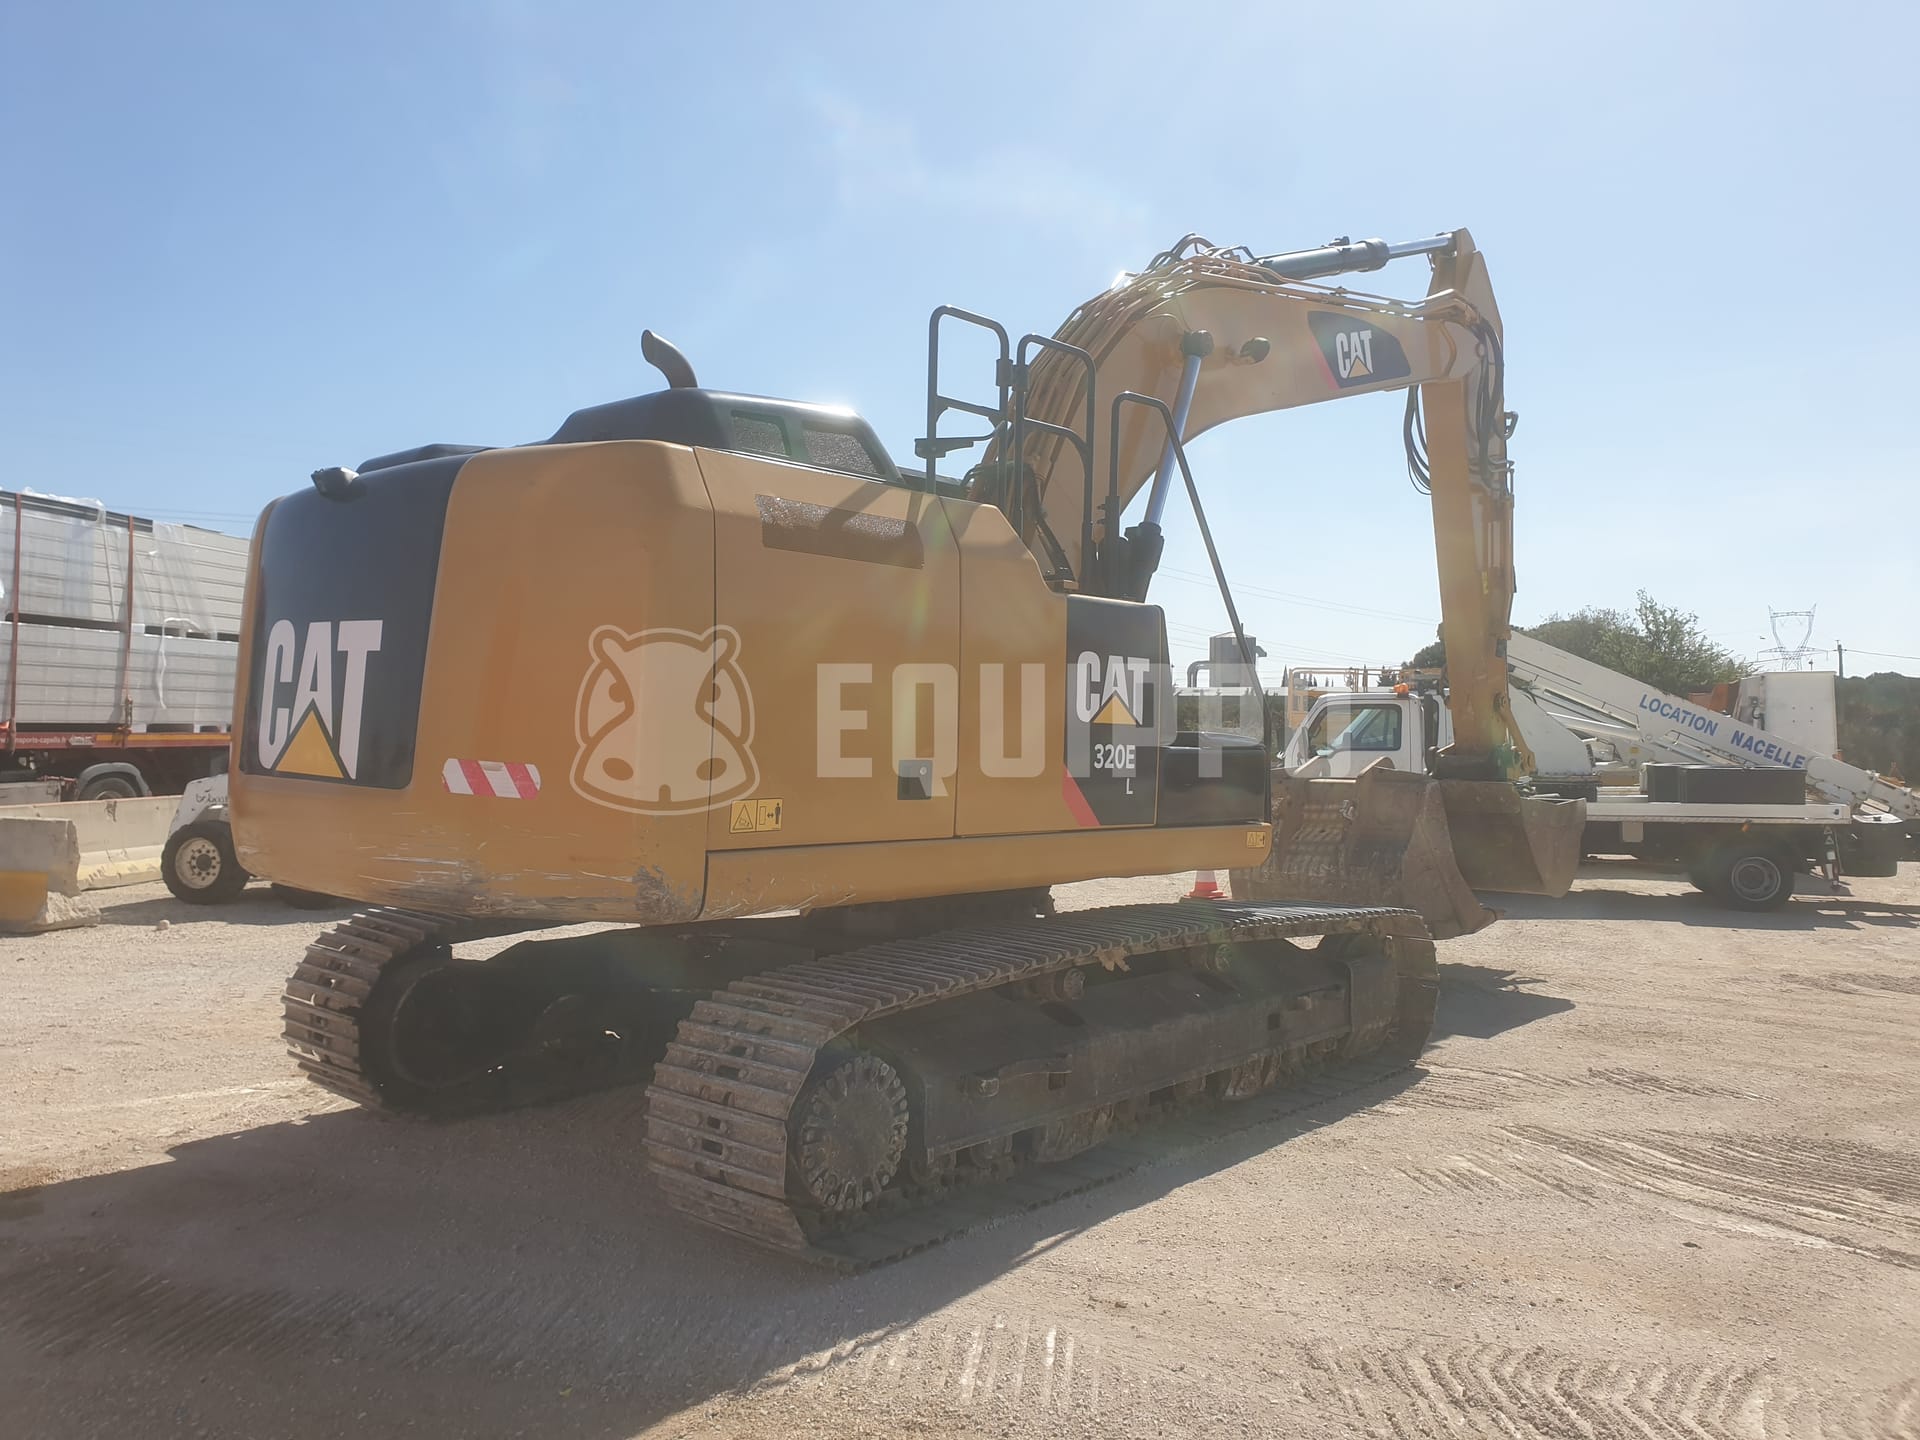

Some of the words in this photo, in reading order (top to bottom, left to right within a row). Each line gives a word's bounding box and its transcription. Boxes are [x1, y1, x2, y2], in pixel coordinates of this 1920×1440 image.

[1336, 330, 1373, 378] CAT
[258, 619, 383, 780] CAT
[1077, 651, 1150, 726] CAT
[1094, 744, 1136, 769] 320E
[1639, 694, 1718, 736] LOCATION
[1731, 730, 1806, 769] NACELLE
[1126, 778, 1133, 795] L
